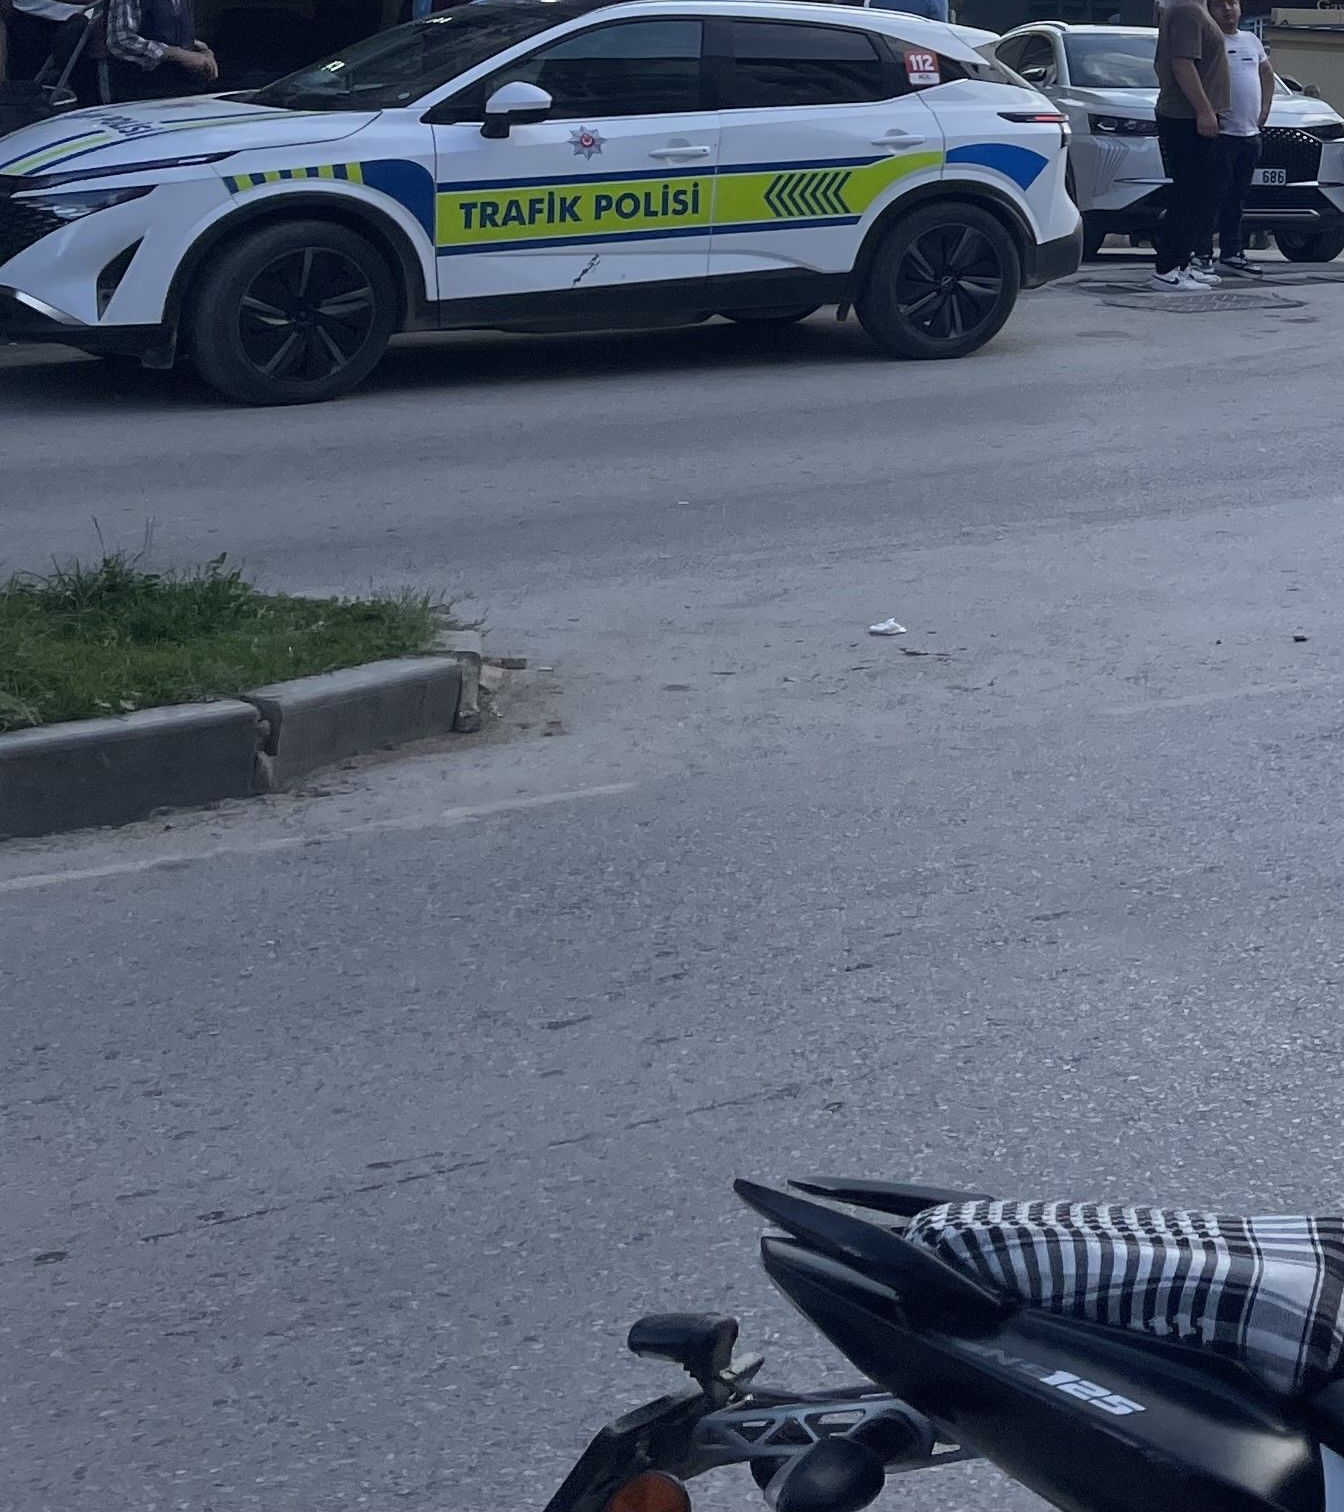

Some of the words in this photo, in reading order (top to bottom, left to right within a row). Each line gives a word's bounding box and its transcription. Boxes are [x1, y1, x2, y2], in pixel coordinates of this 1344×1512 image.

[909, 54, 935, 71] 112
[1263, 170, 1285, 184] 686
[459, 191, 583, 230] TRAFİK
[594, 181, 699, 220] POLİSİ
